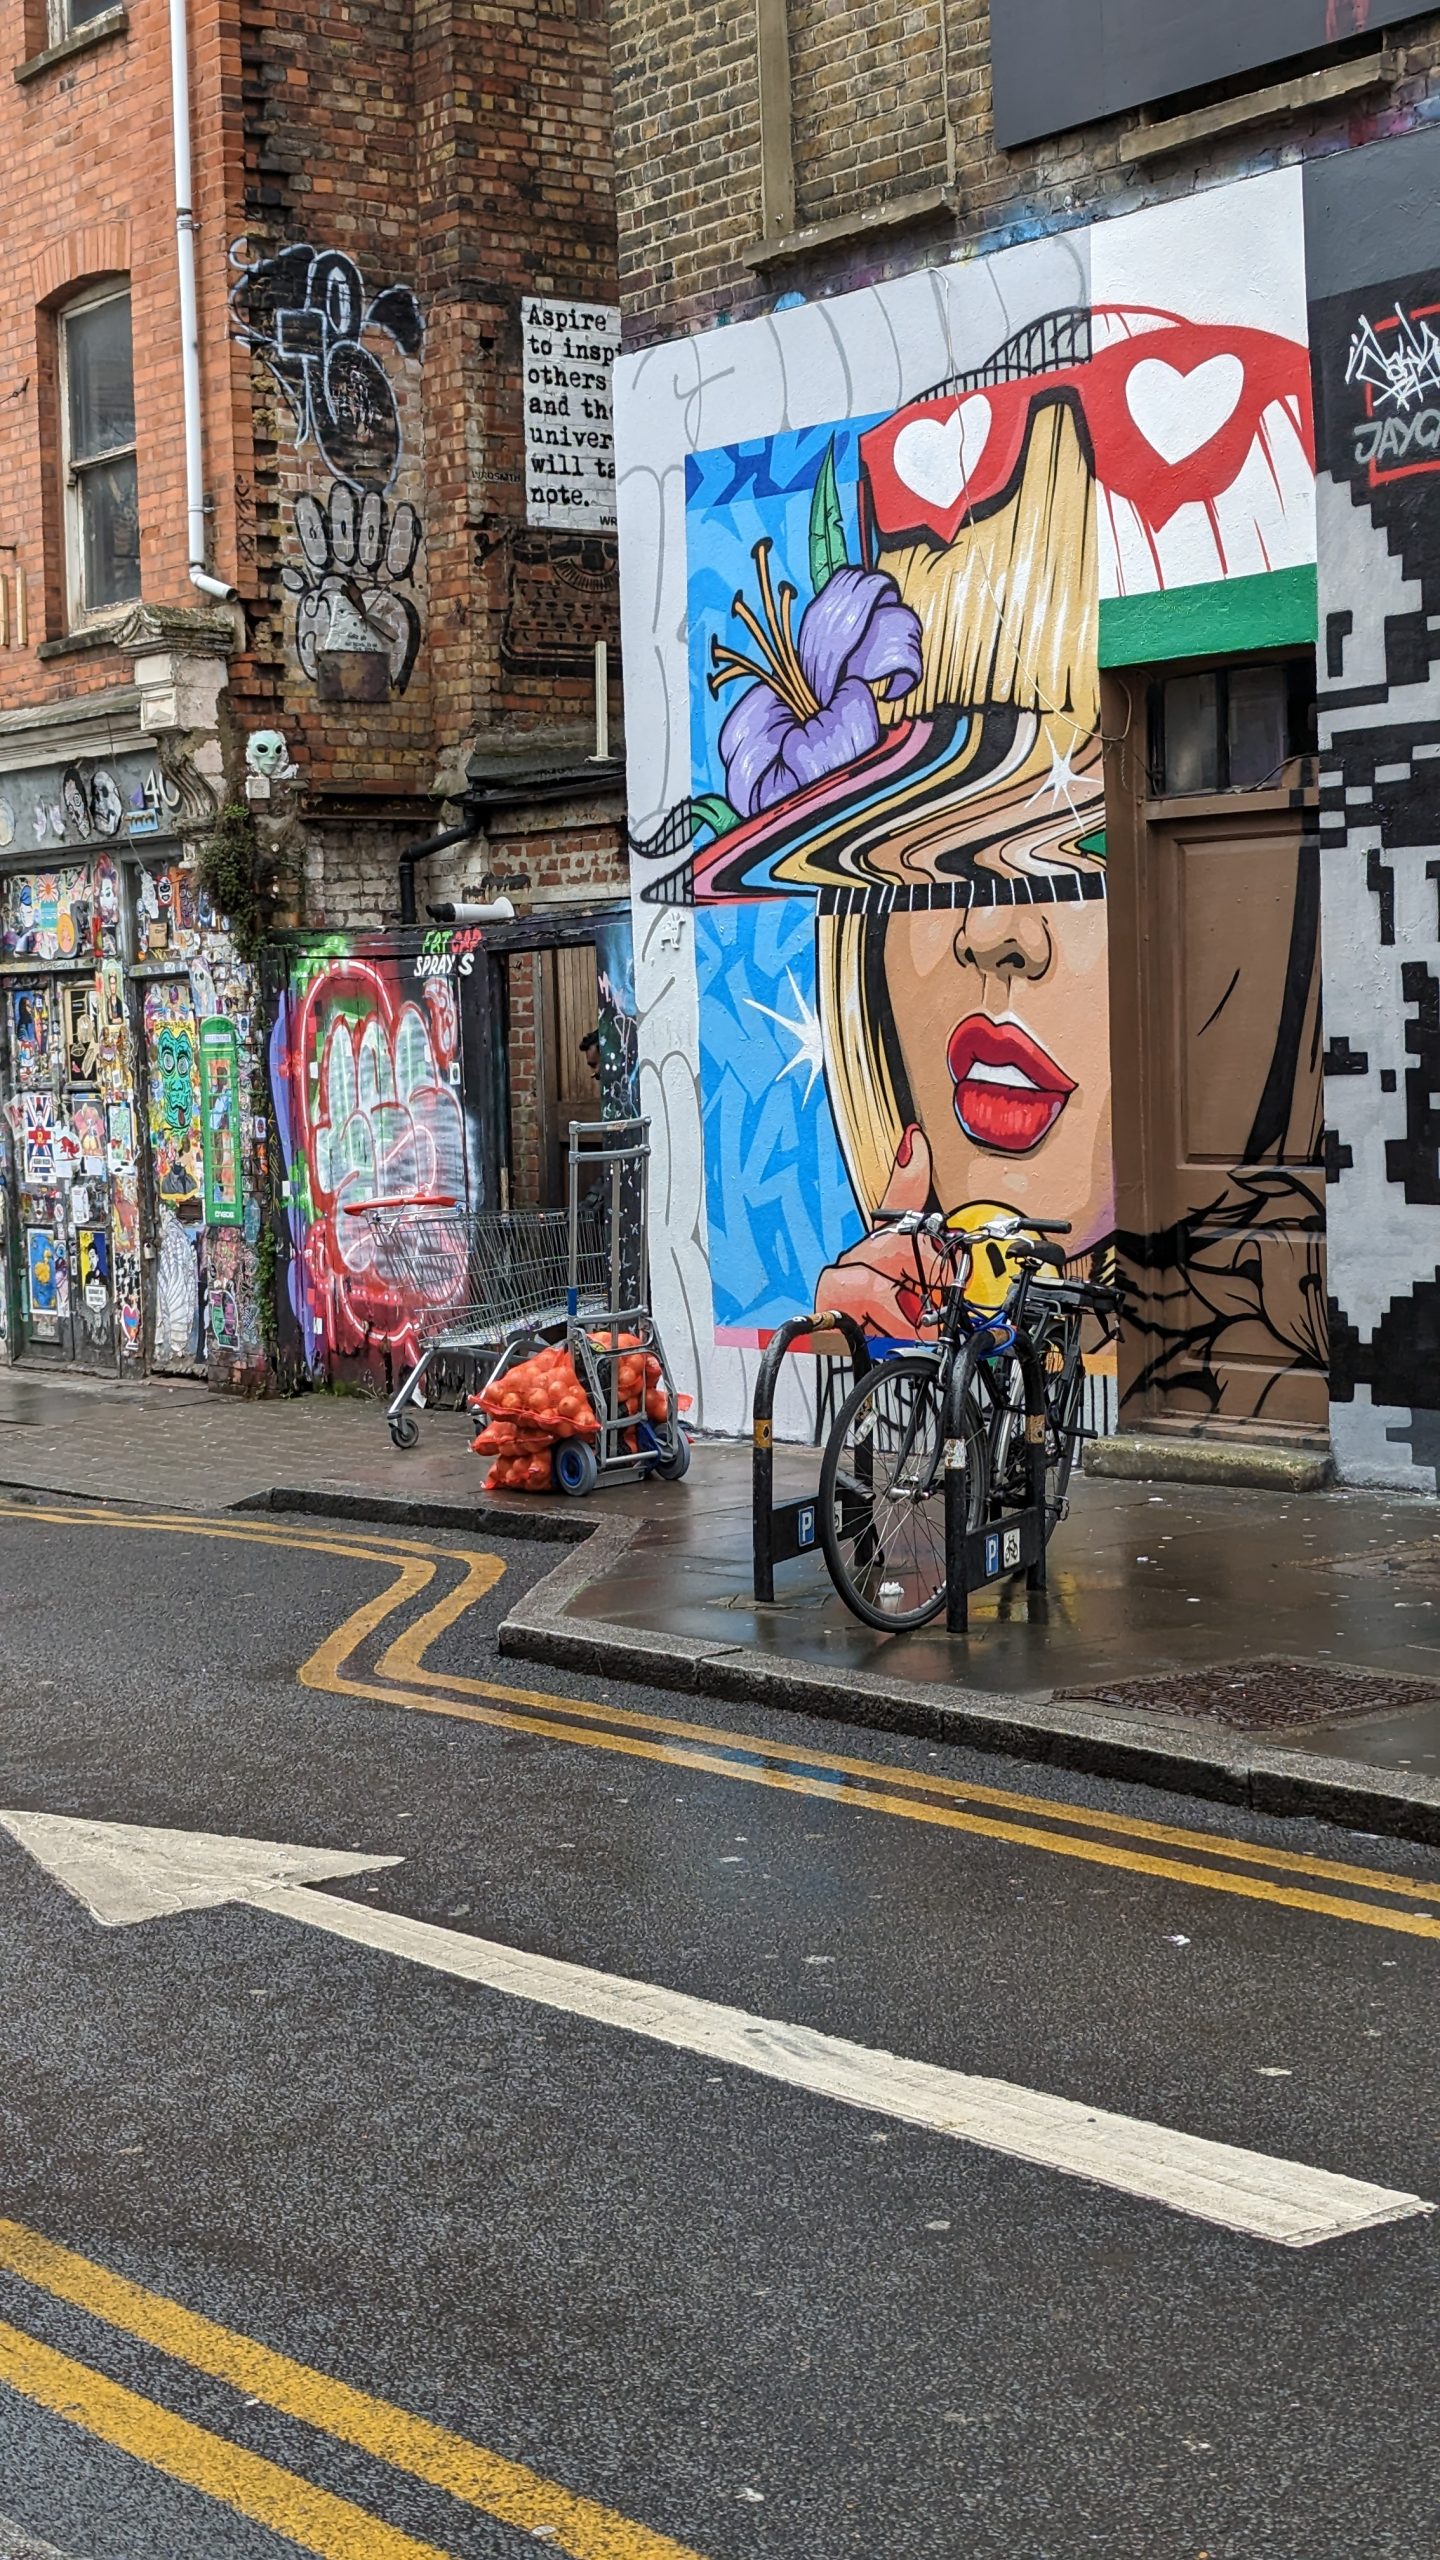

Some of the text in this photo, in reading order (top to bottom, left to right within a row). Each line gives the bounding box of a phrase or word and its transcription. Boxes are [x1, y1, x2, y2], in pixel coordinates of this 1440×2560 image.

[527, 303, 607, 332] Aspire
[527, 334, 553, 356] to
[528, 364, 607, 391] others
[529, 395, 614, 420] and th
[531, 453, 584, 477] will
[529, 484, 590, 508] note.
[801, 1511, 813, 1542] P
[988, 1538, 997, 1572] P
